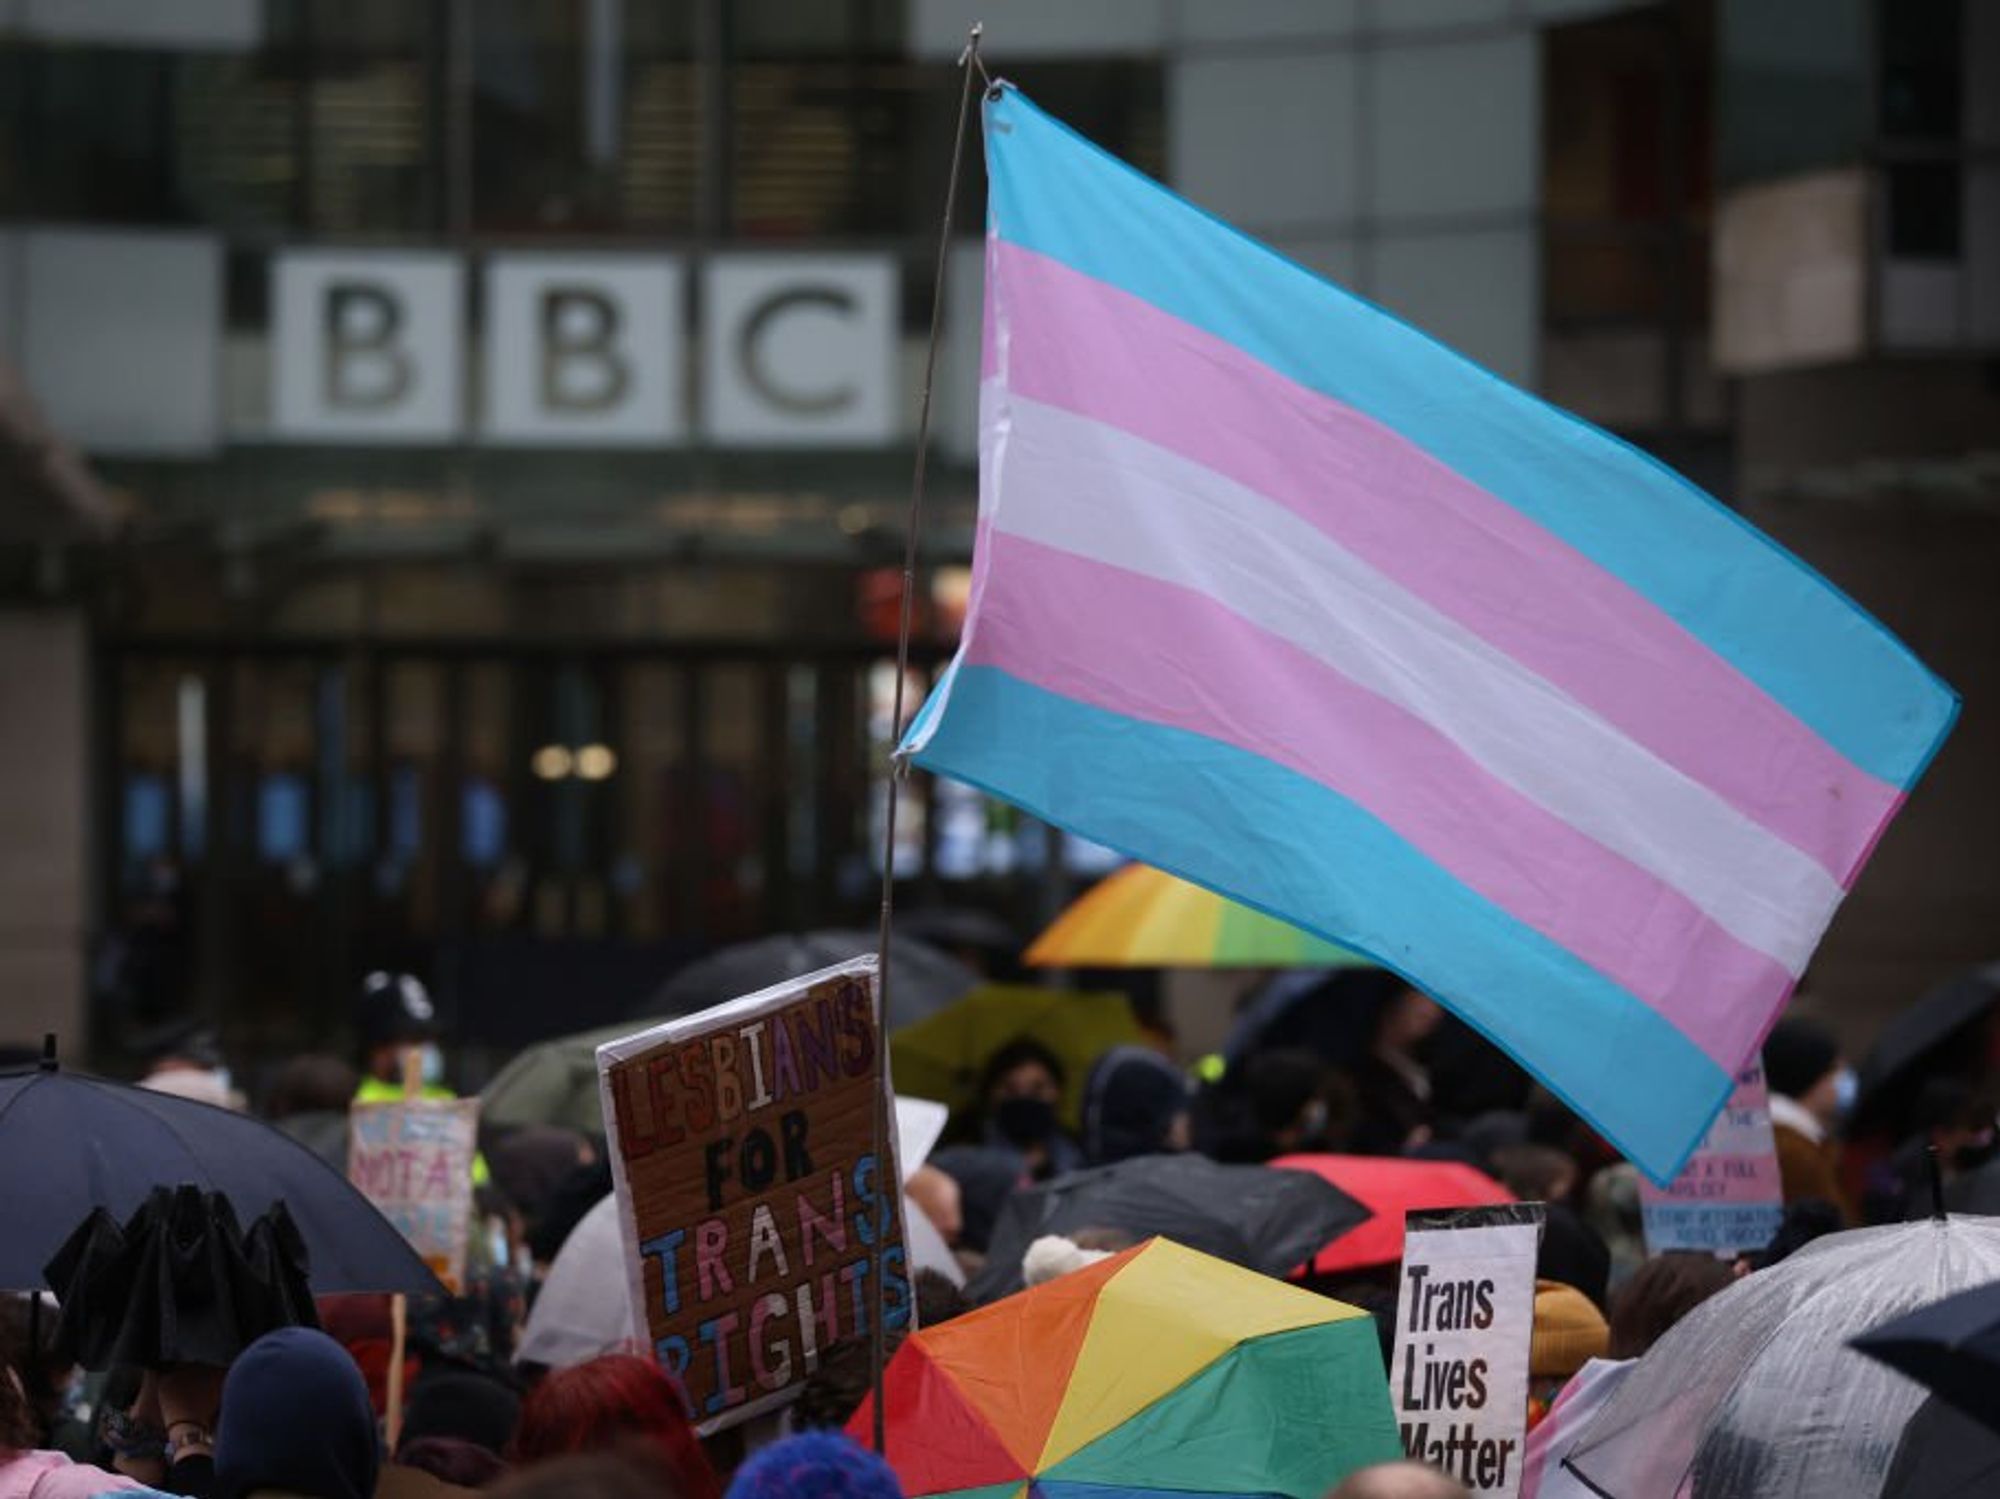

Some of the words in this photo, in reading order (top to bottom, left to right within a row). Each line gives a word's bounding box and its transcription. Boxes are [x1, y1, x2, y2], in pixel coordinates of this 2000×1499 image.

[322, 278, 862, 418] BBC
[614, 982, 877, 1158] LESBIANS
[704, 1110, 816, 1211] FOR
[641, 1153, 894, 1315] TRANS
[655, 1246, 911, 1420] RIGHTS
[1407, 1264, 1494, 1333] Trans
[1402, 1343, 1488, 1412] Lives
[1400, 1422, 1515, 1490] Matter
